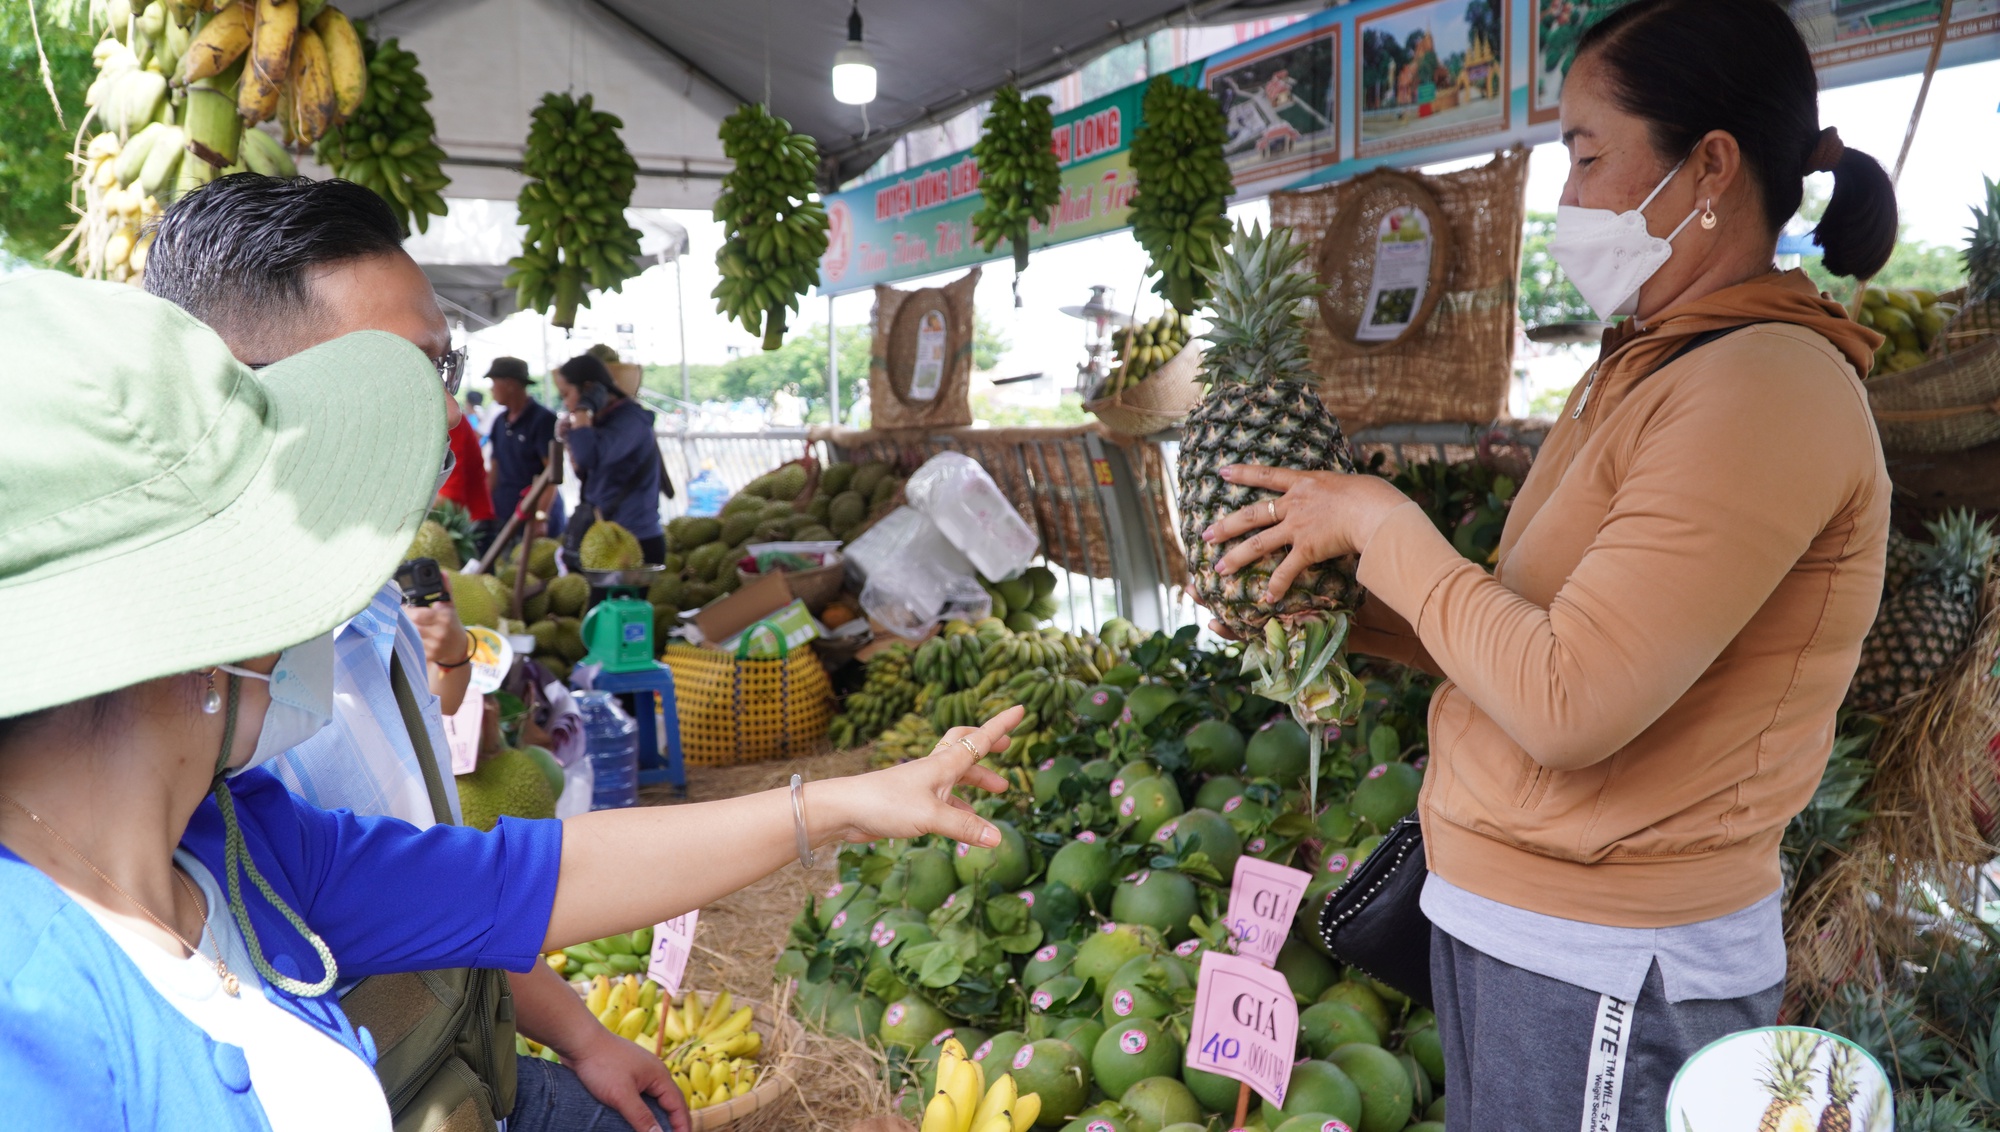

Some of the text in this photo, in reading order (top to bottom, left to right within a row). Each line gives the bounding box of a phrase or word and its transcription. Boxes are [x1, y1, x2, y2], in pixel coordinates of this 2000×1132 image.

[1074, 106, 1120, 161] LONG
[1253, 889, 1292, 924] GIÁ
[1232, 993, 1278, 1042] GIÁ
[1202, 1032, 1240, 1063] 40
[1602, 1080, 1614, 1107] WILL
